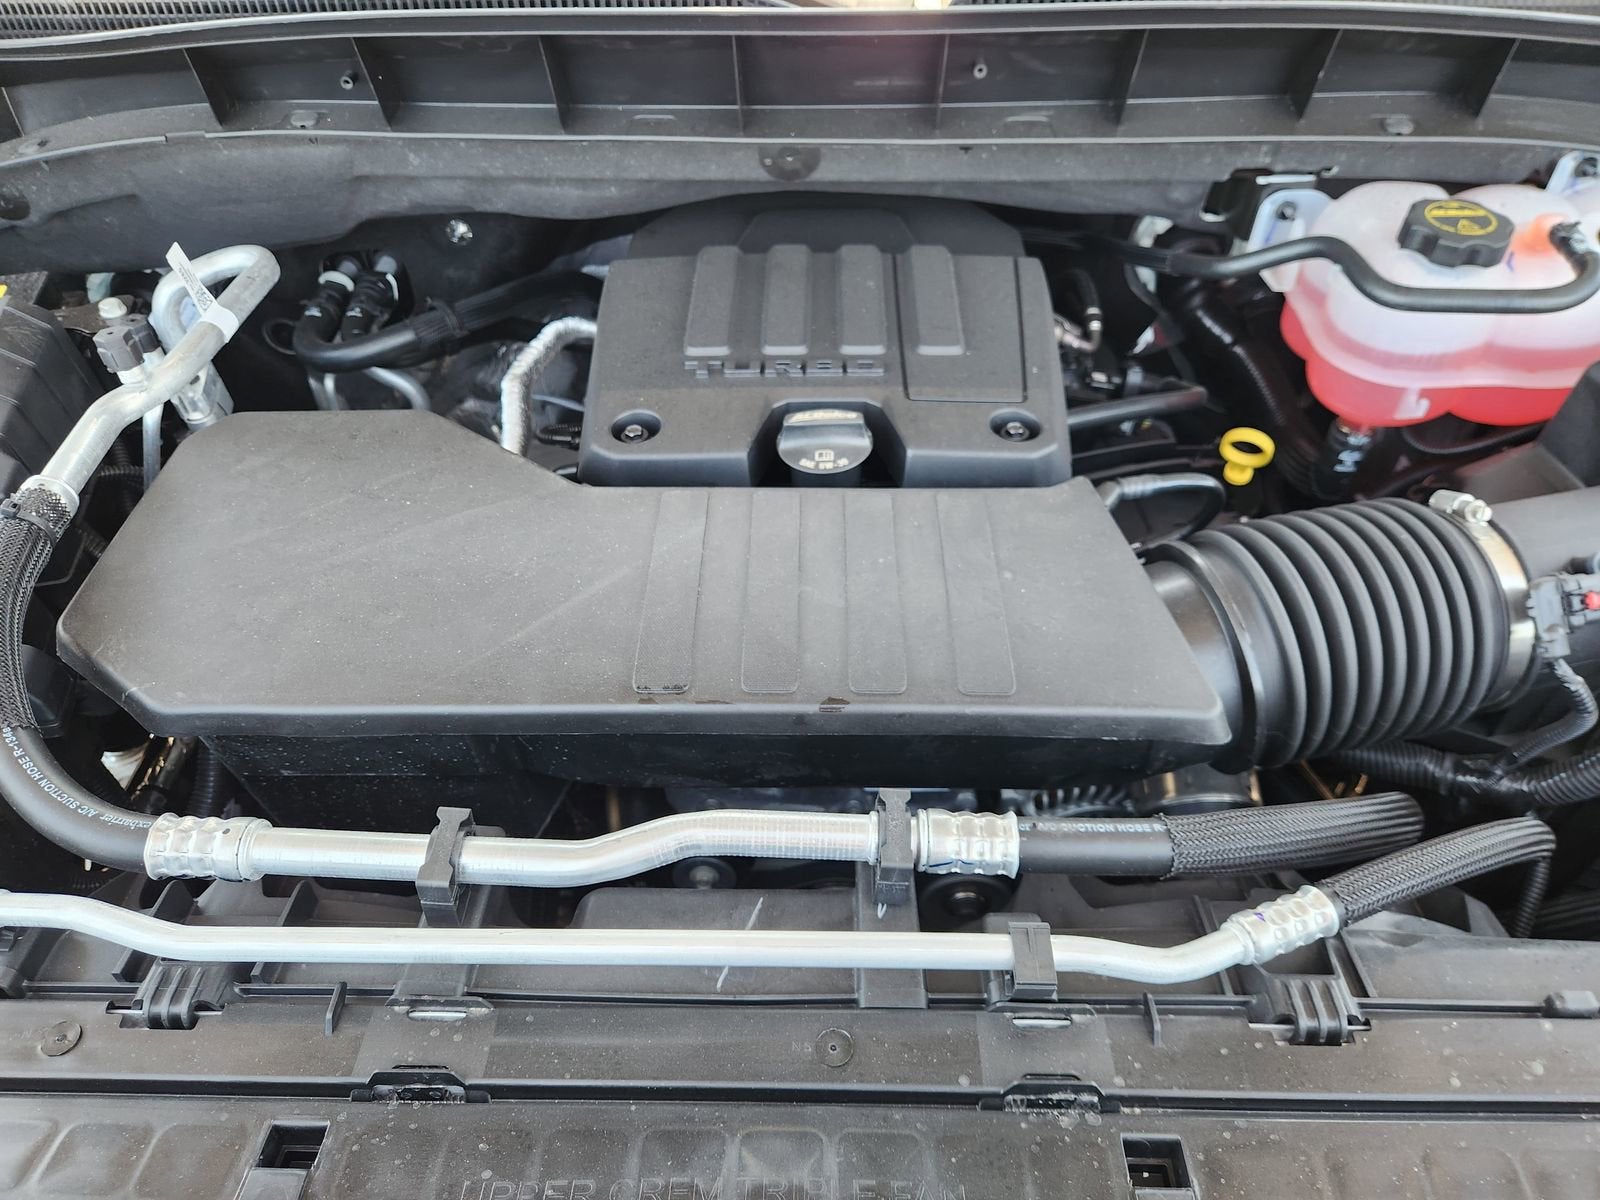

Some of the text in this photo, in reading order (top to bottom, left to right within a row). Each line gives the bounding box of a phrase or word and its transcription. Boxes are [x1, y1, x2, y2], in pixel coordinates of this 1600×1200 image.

[684, 360, 885, 379] TURBO
[18, 757, 43, 783] HOSE
[40, 778, 81, 809] SUCTION
[79, 807, 99, 818] A/C
